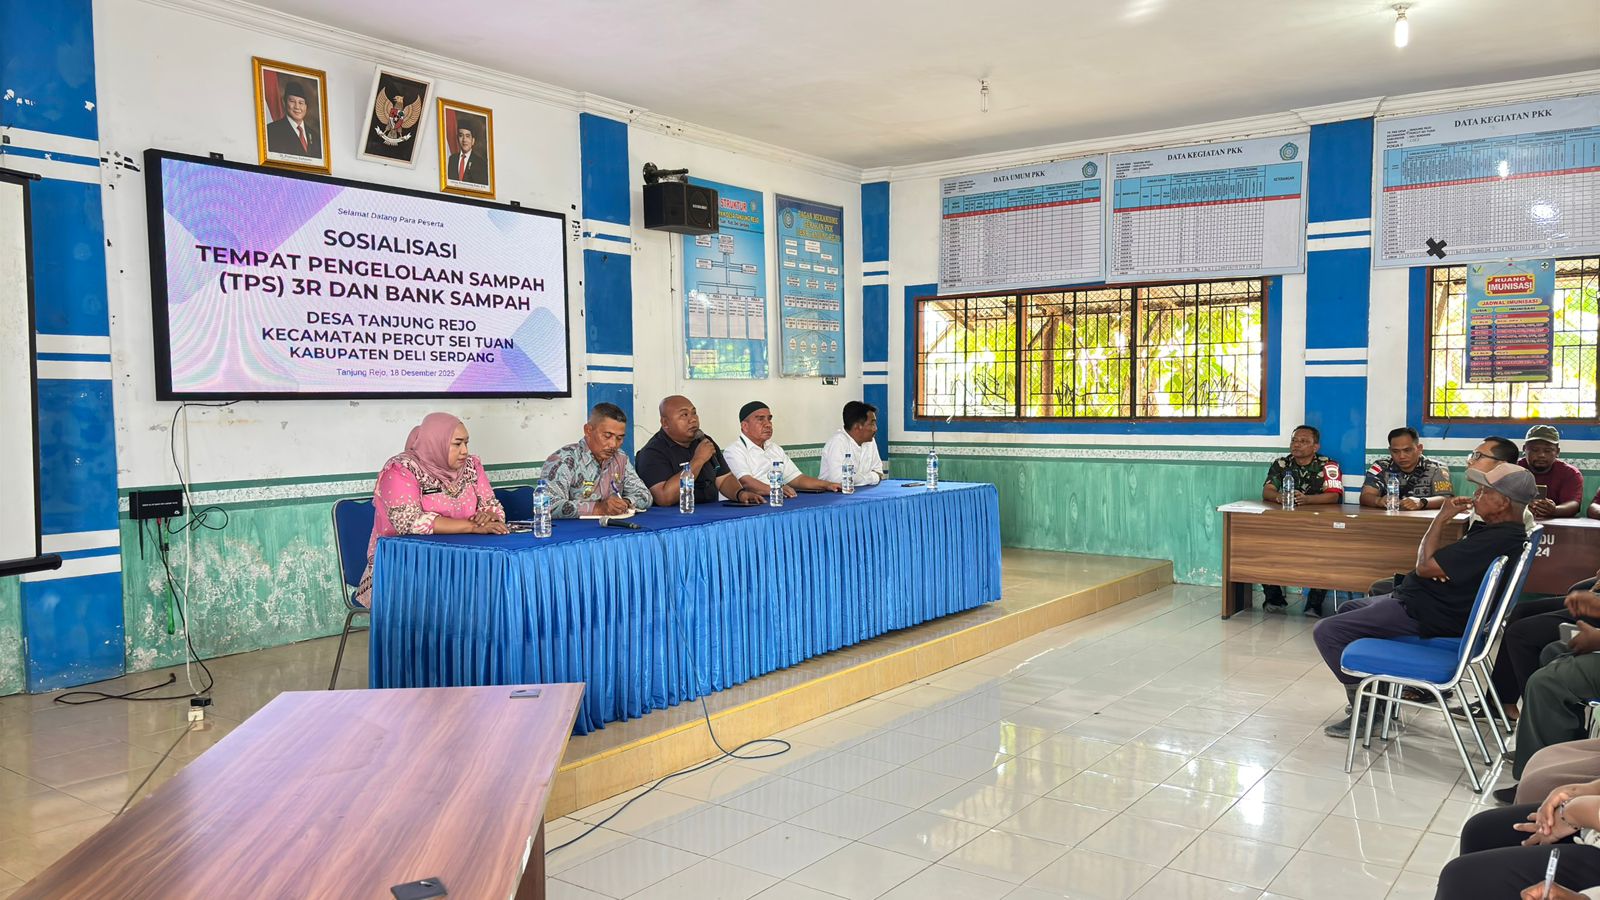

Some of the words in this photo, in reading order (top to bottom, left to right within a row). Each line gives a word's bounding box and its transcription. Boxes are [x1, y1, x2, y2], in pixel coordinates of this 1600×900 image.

[1454, 118, 1478, 127] DATA
[1480, 111, 1529, 125] KEGIATAN
[1532, 109, 1552, 119] PKK
[1167, 153, 1186, 161] DATA
[1188, 148, 1226, 159] KEGIATAN
[1227, 147, 1243, 155] PKK
[993, 175, 1009, 183] DATA
[1010, 173, 1031, 181] UMUM
[1032, 170, 1045, 178] PKK
[720, 197, 747, 212] STRUKTUR
[337, 207, 369, 217] Selamat
[371, 212, 397, 223] Datang
[400, 216, 415, 224] Para
[417, 218, 444, 228] Peserta
[323, 229, 457, 259] SOSIALISASI
[195, 244, 301, 270] TEMPAT
[308, 256, 464, 285] PENGELOLAAN
[469, 272, 545, 292] SAMPAH
[219, 271, 284, 298] (TPS)
[292, 278, 322, 297] 3R
[329, 281, 378, 300] DAN
[386, 285, 445, 305] BANK
[450, 291, 530, 311] SAMPAH
[1488, 282, 1532, 291] IMUNISASI
[307, 311, 354, 326] DESA
[358, 314, 434, 330] TANJUNG
[439, 319, 477, 332] REJO
[262, 327, 377, 344] KECAMATAN
[382, 332, 445, 347] PERCUT
[449, 335, 471, 348] SEI
[475, 337, 514, 350] TUAN
[289, 346, 389, 360] KABUPATEN
[393, 349, 426, 361] DELI
[430, 351, 495, 363] SERDANG
[336, 368, 367, 377] Tanjung
[401, 369, 437, 377] Desember
[1535, 546, 1550, 557] 24
